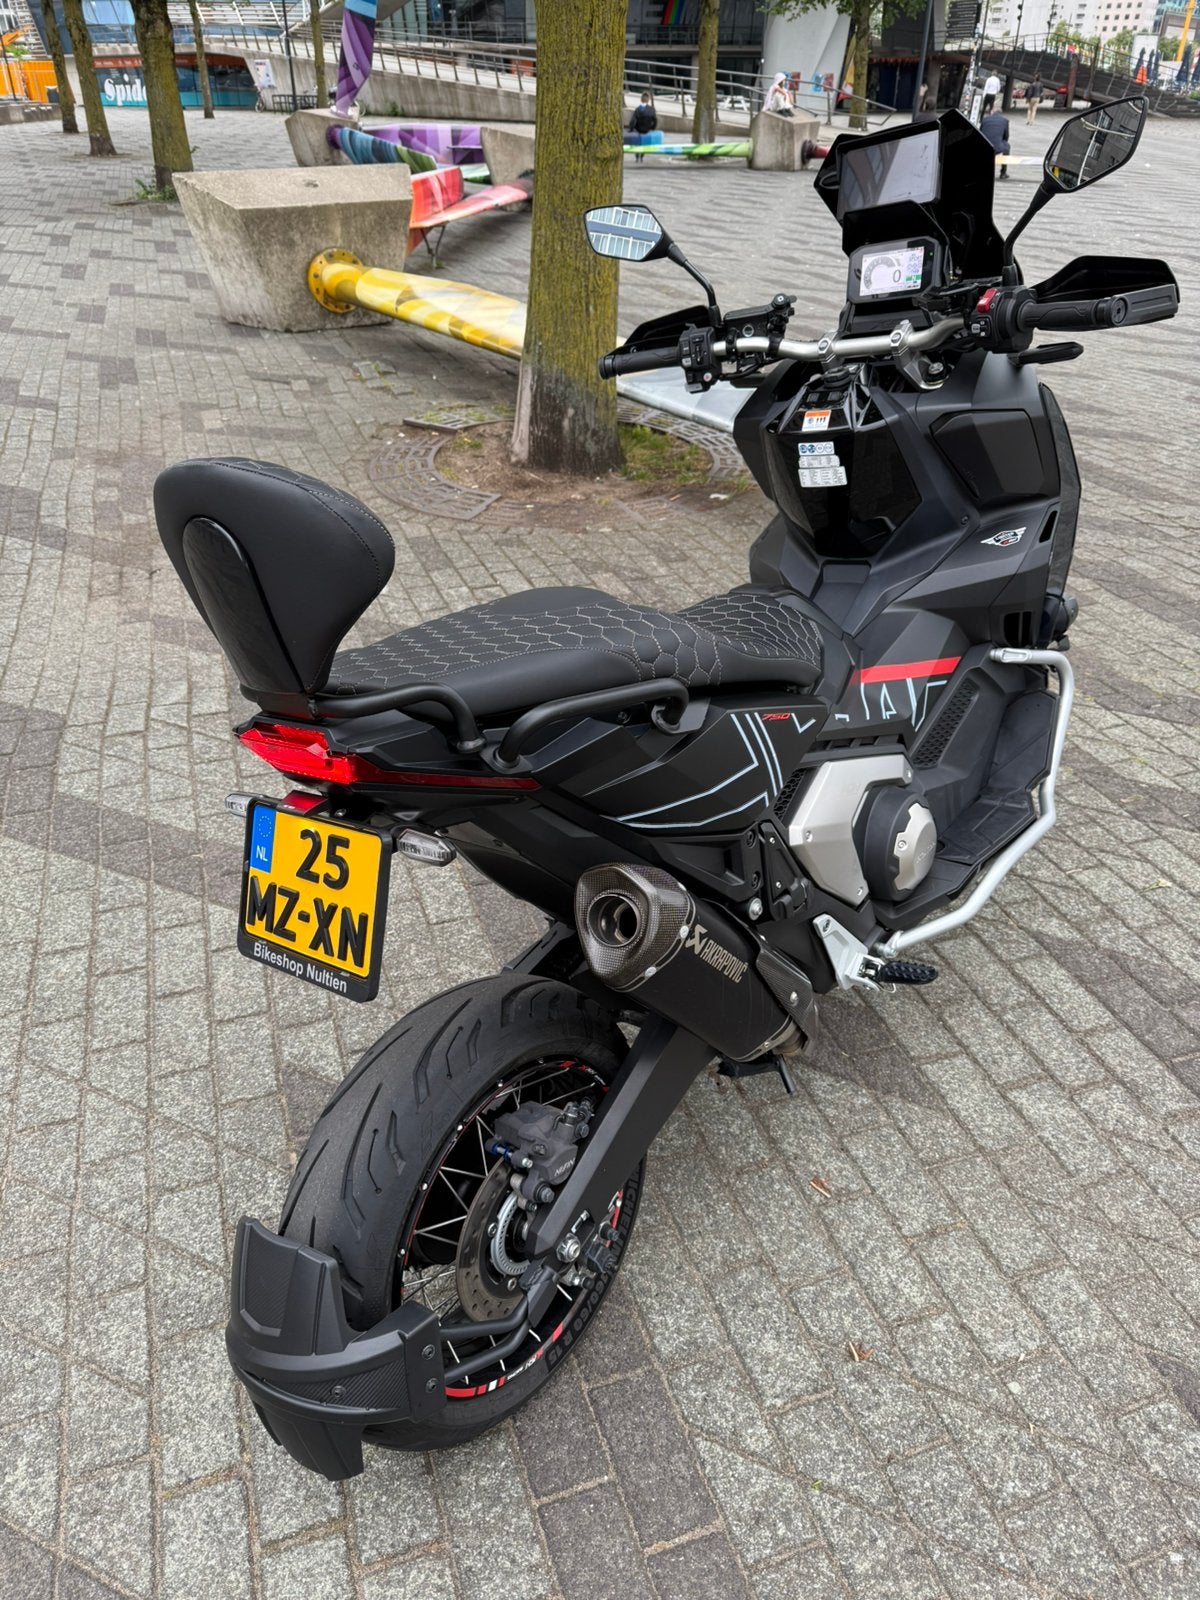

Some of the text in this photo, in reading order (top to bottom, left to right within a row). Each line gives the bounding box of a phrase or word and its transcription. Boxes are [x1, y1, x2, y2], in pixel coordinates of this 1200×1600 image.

[762, 712, 791, 721] 750
[256, 845, 268, 862] NL
[296, 829, 350, 890] 25
[247, 875, 369, 968] MZ-XN
[254, 941, 347, 993] Bikeshop Nultien
